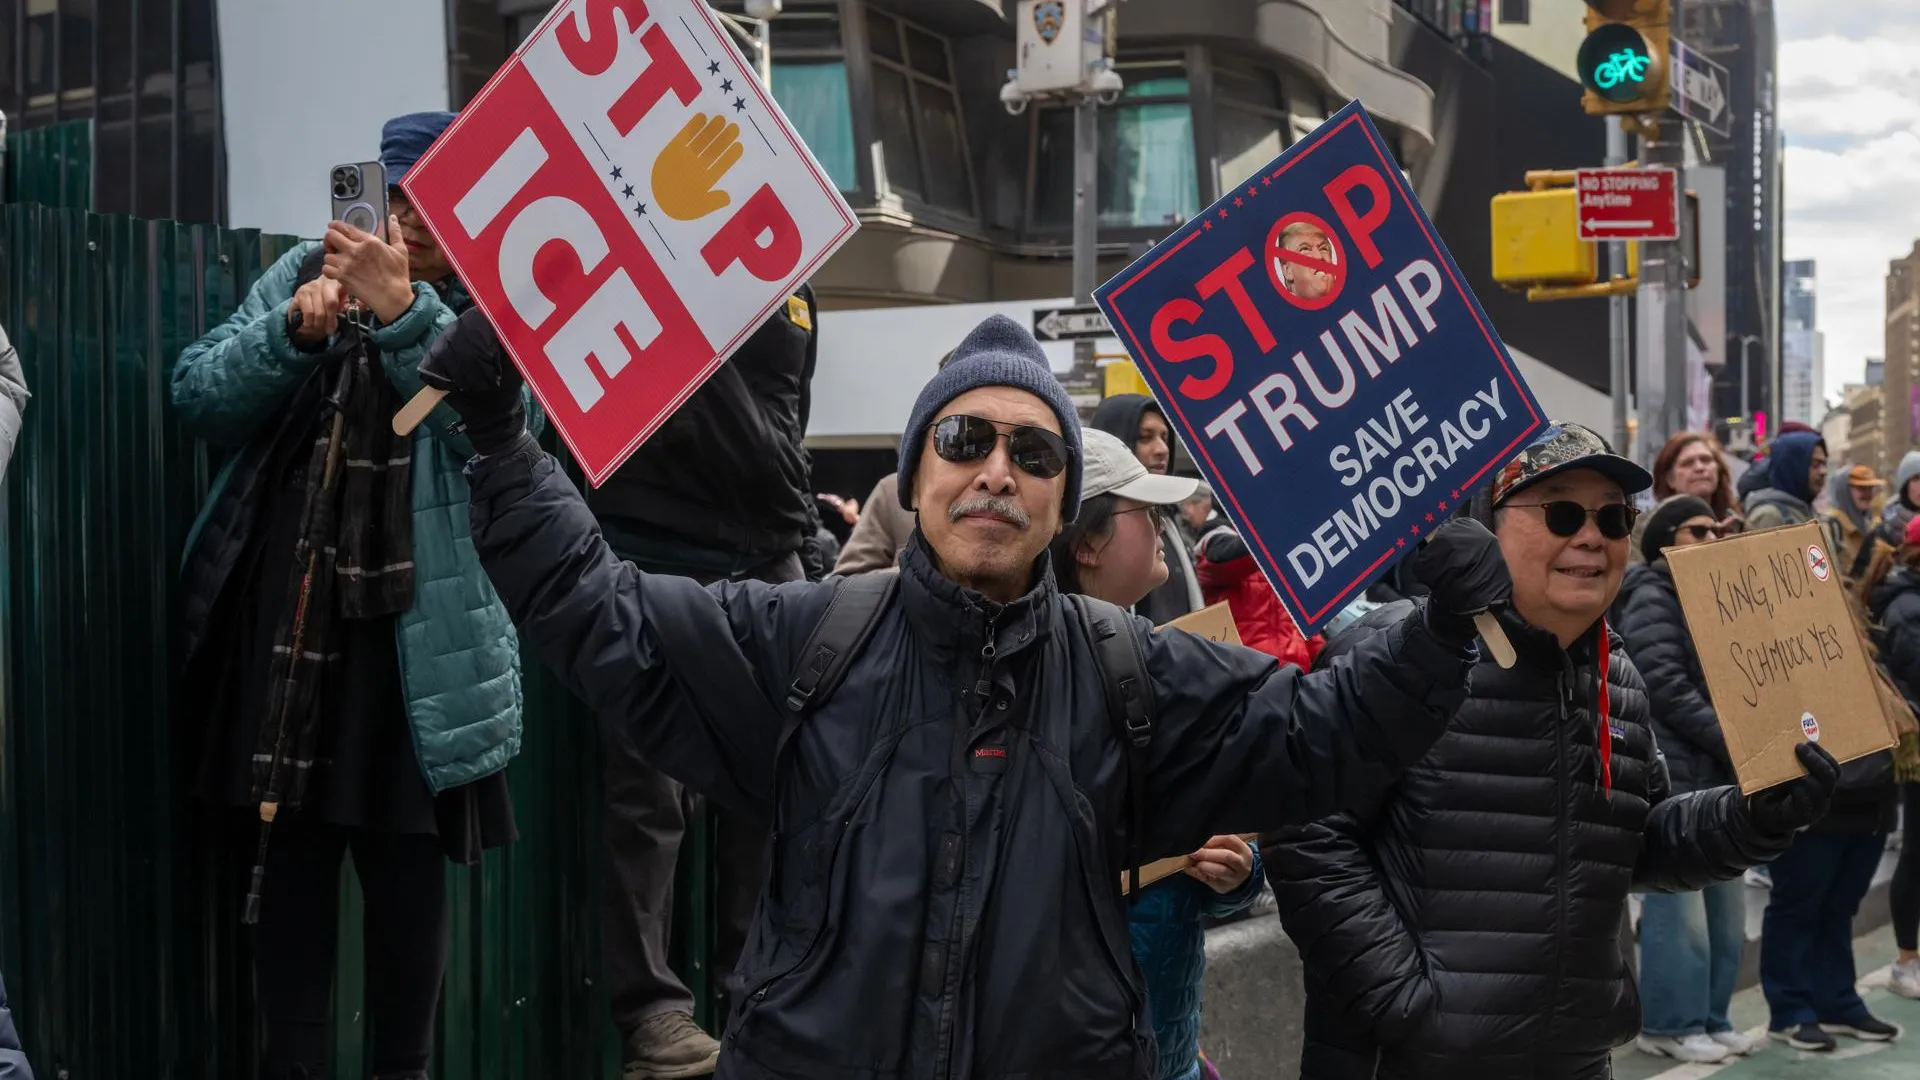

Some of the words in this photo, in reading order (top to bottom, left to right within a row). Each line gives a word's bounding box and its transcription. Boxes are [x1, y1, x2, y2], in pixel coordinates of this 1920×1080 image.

[555, 0, 802, 281] STP
[1582, 177, 1600, 191] NO
[1601, 176, 1659, 190] STOPPING
[1583, 193, 1632, 209] Anytime
[453, 127, 663, 413] ICE
[1150, 164, 1391, 400] STOP
[1084, 315, 1108, 329] WA
[1204, 259, 1443, 477] TRUMP
[1286, 378, 1509, 590] DEMOCRACY
[1329, 388, 1429, 486] SAVE
[1767, 548, 1814, 605] NO!
[1730, 633, 1813, 708] SCHMUCK
[1807, 623, 1843, 671] YES
